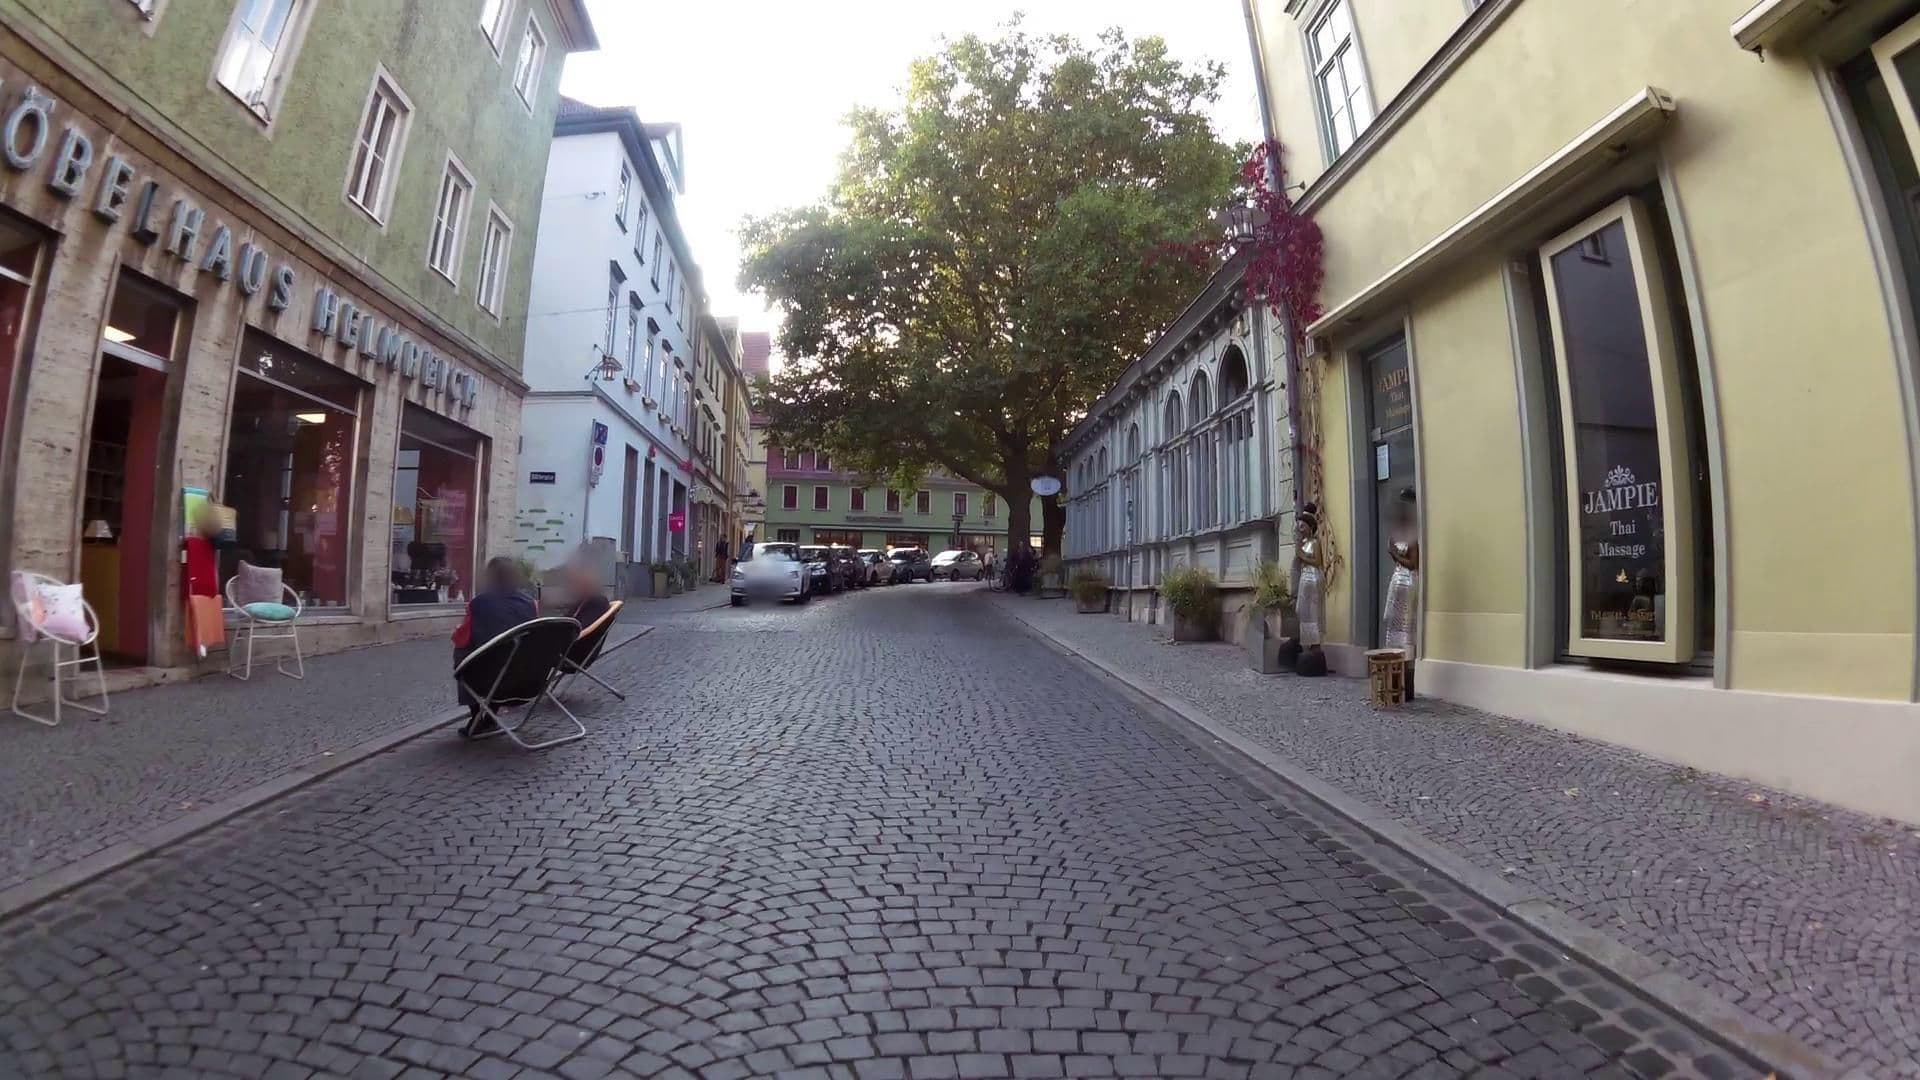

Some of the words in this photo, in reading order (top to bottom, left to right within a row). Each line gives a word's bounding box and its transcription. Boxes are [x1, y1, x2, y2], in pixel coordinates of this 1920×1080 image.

[0, 80, 296, 311] ÖBELHAUS
[1584, 482, 1659, 514] JAMPIE
[1610, 520, 1636, 536] Thai
[1599, 542, 1646, 559] Massage
